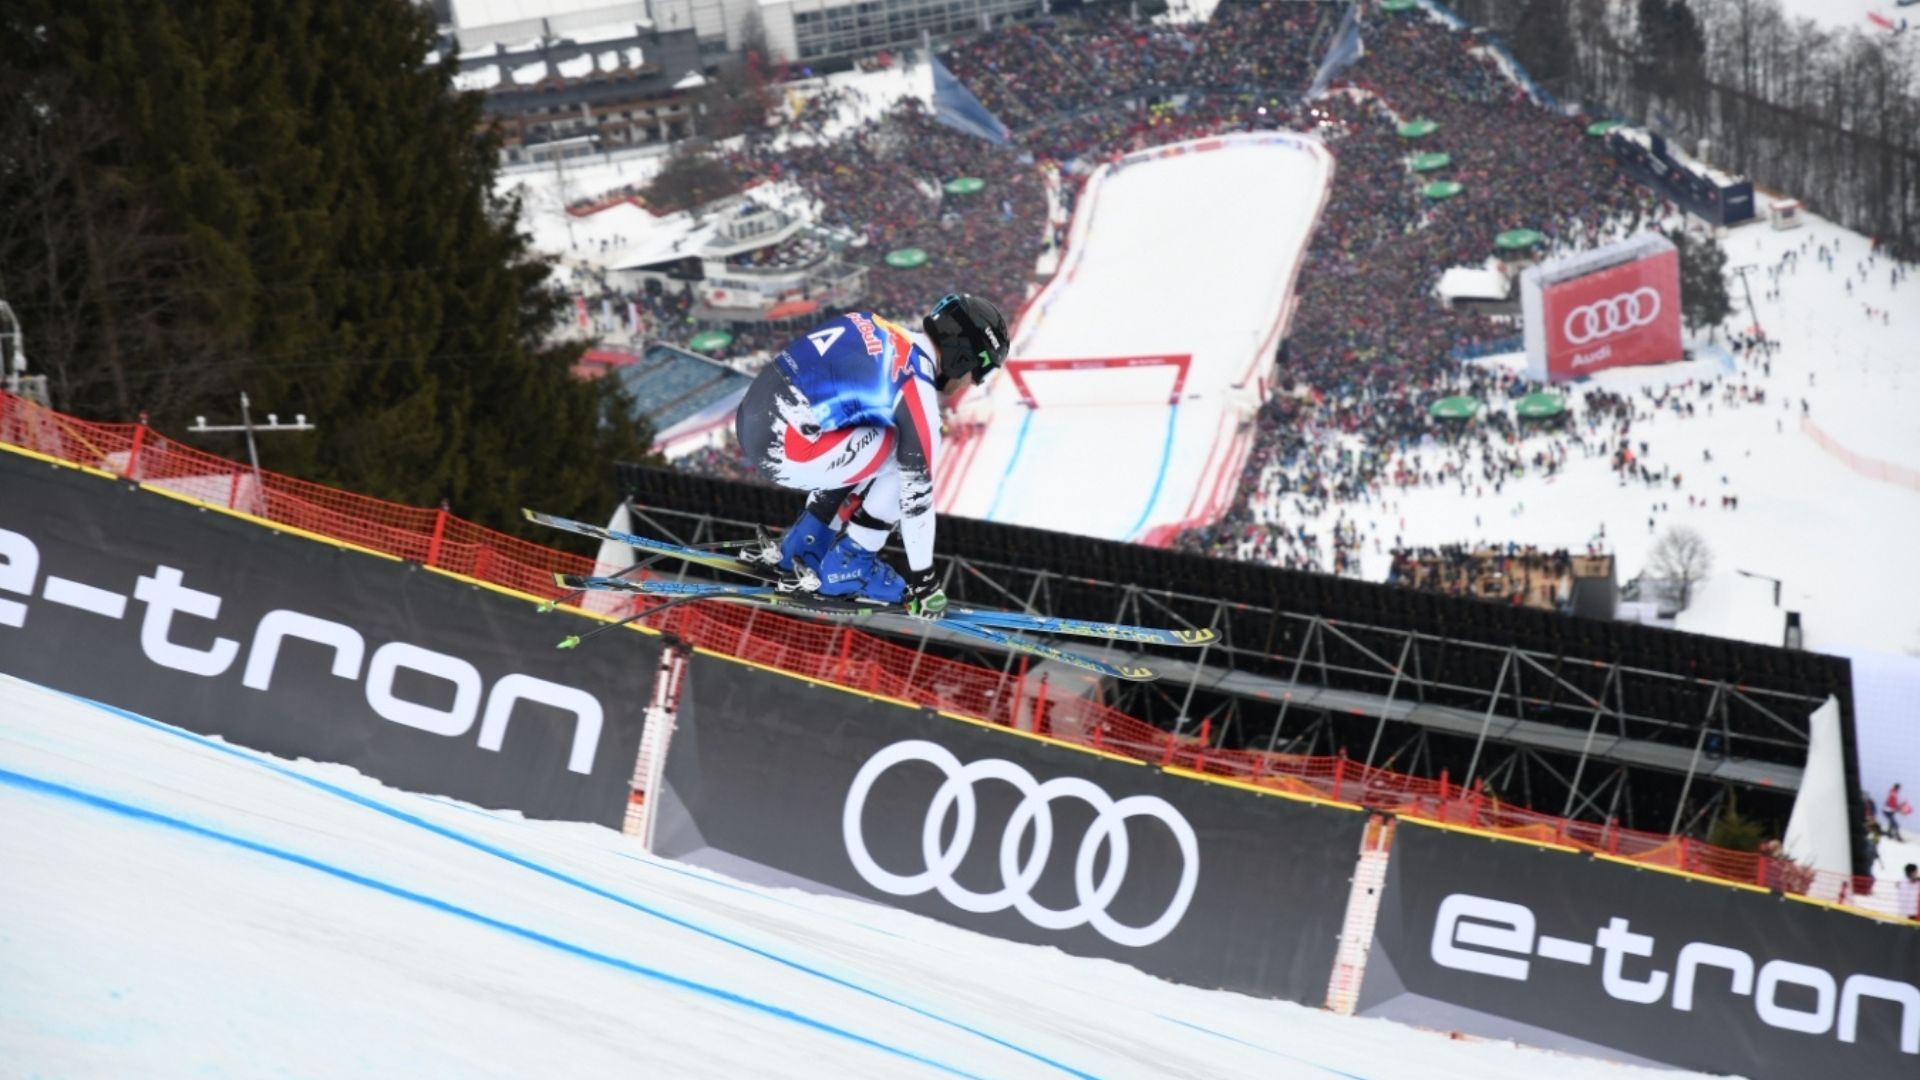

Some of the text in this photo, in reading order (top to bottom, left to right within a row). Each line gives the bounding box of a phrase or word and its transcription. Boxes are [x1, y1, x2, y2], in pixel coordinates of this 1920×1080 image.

[1572, 345, 1612, 367] Audi
[0, 528, 604, 775] -tron
[1431, 893, 1920, 1053] e-tron
